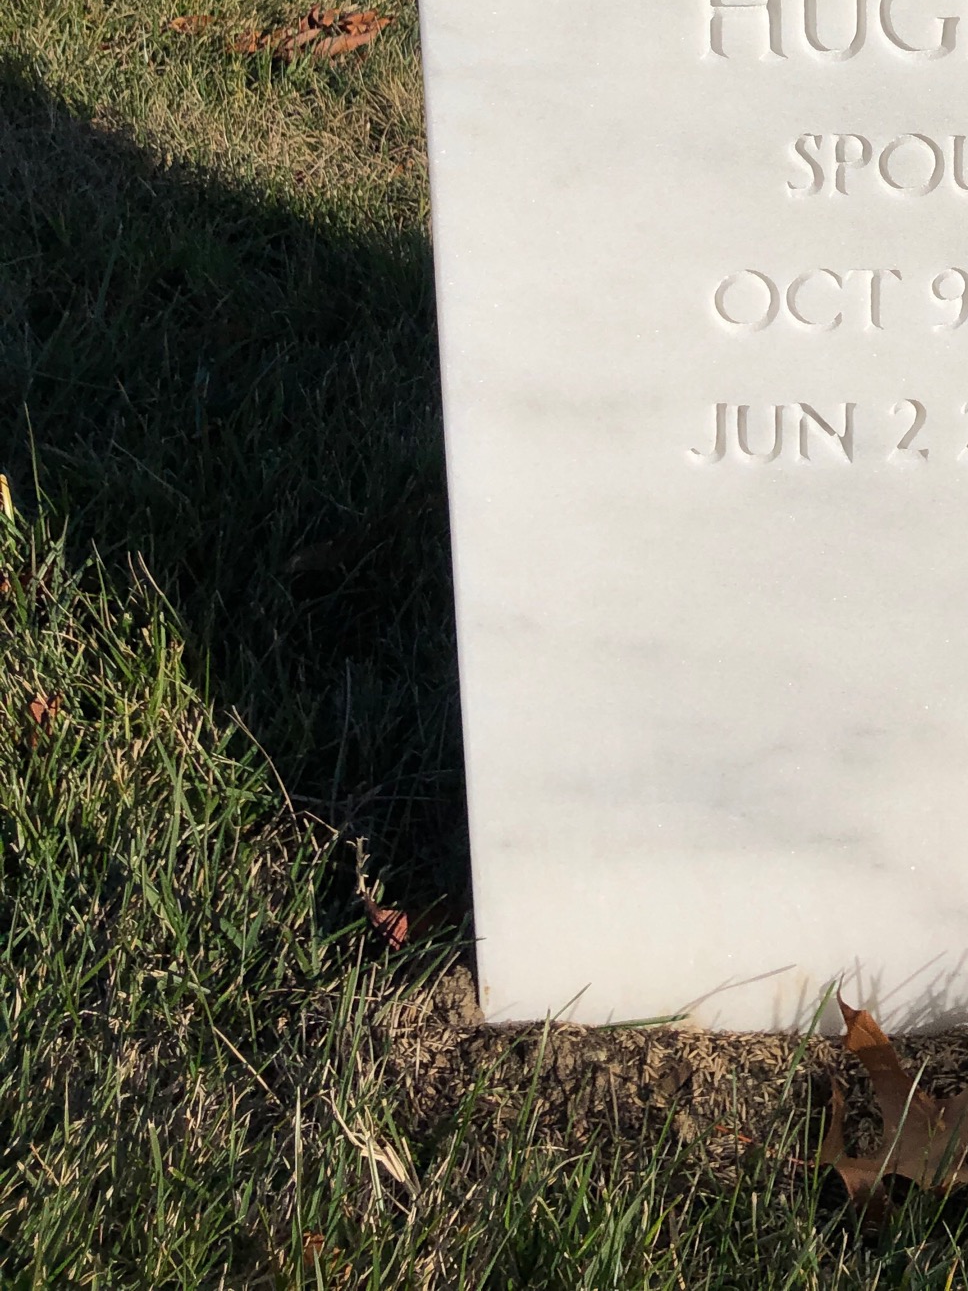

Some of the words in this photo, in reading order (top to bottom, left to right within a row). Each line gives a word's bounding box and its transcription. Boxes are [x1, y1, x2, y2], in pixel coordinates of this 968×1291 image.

[713, 267, 902, 332] OCT
[689, 401, 857, 464] JUN
[888, 398, 929, 461] 2
